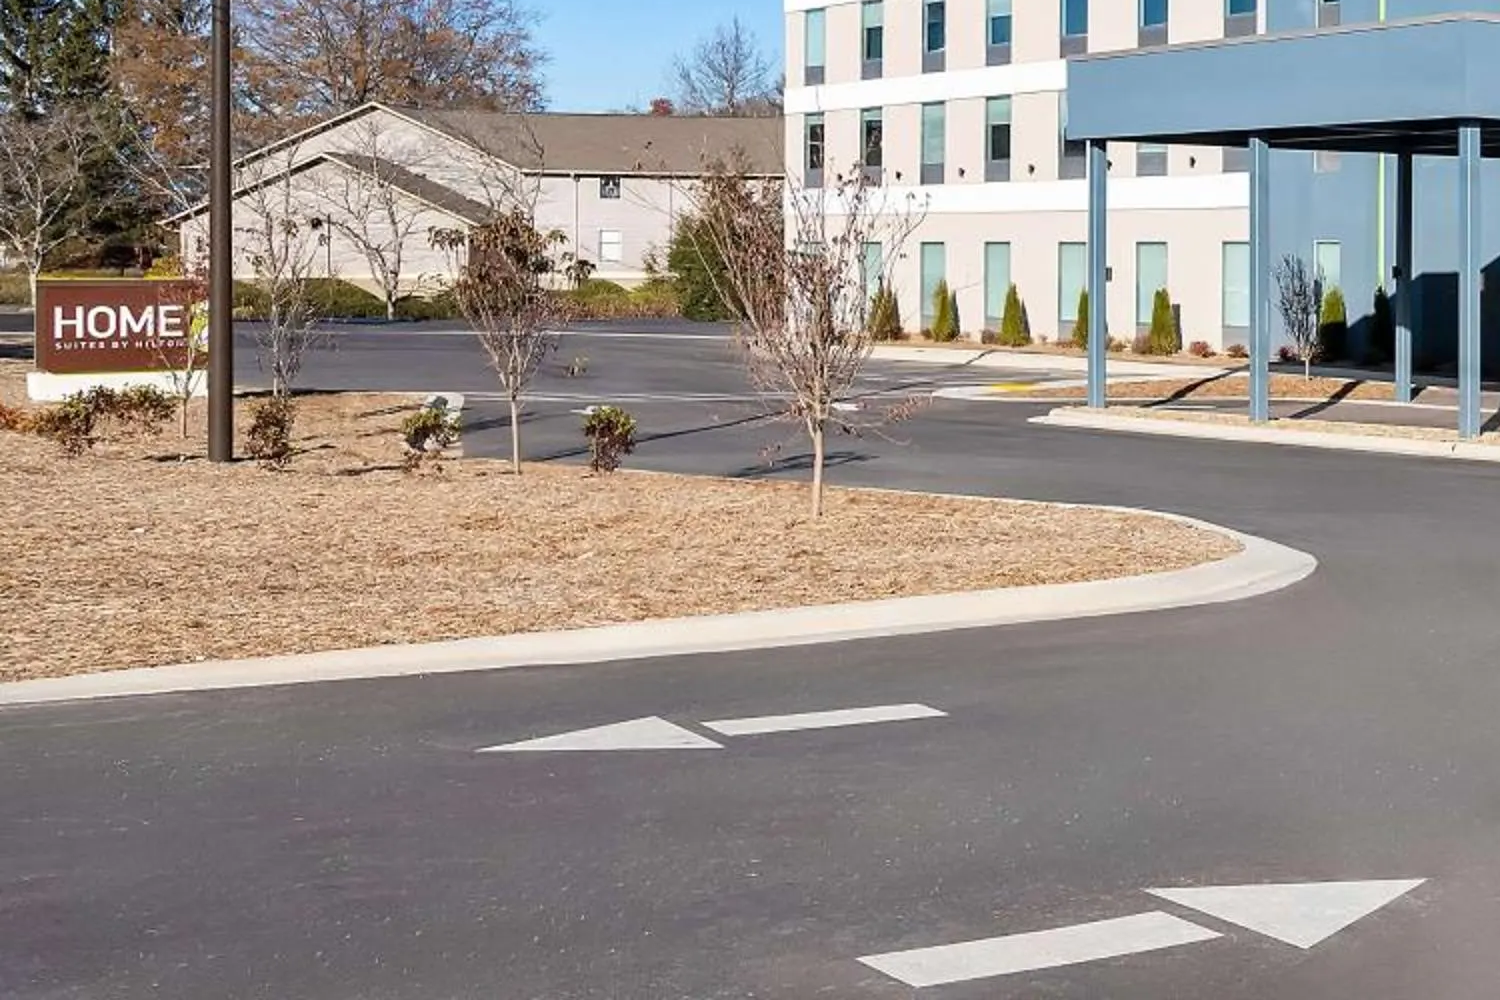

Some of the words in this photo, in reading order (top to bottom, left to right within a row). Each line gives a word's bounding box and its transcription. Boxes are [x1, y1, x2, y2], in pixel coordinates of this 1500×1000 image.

[54, 304, 184, 339] HOME
[55, 341, 105, 351] SUITES
[111, 341, 128, 350] BY
